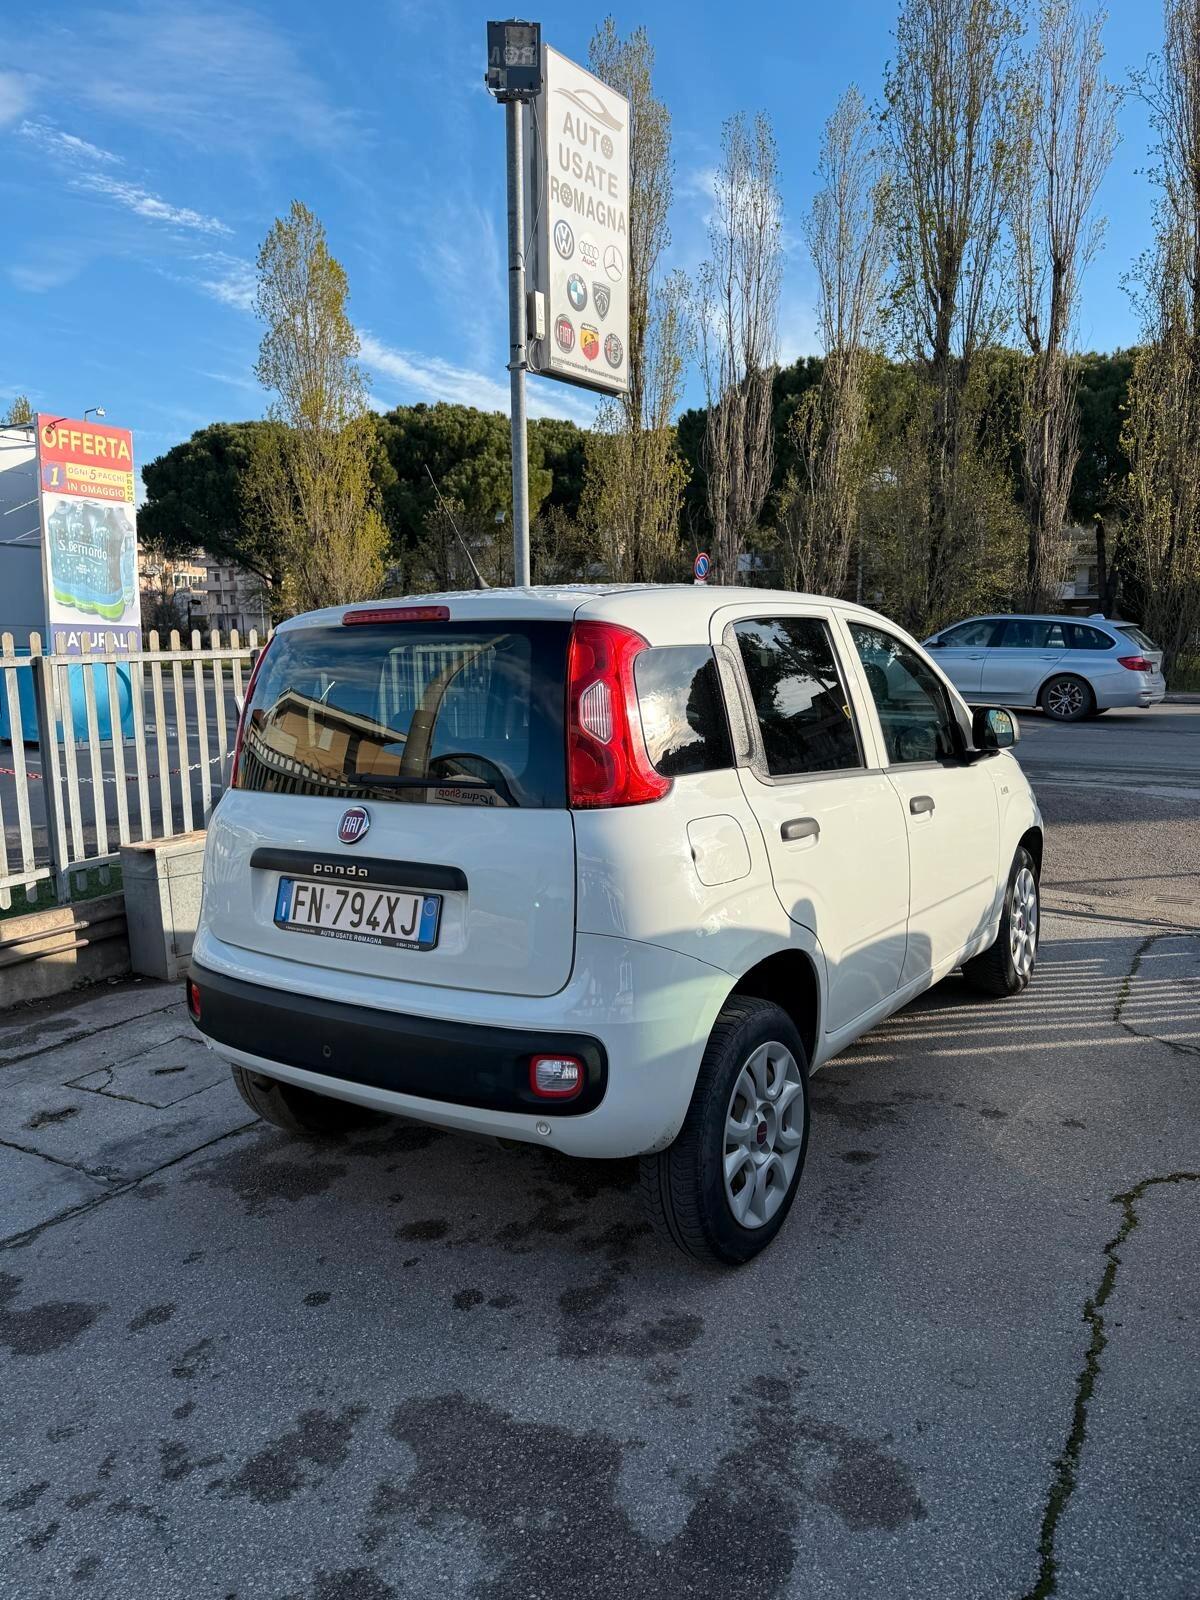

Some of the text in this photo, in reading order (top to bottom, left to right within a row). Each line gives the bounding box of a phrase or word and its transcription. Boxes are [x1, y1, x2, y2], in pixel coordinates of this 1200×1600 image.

[563, 111, 614, 160] AUTO
[558, 142, 618, 199] USATE
[551, 175, 626, 236] ROMAGNA
[559, 324, 572, 347] FIAT
[41, 425, 131, 461] OFFERTA
[50, 466, 59, 486] 1
[68, 466, 125, 483] OGNI 5 PACCHI
[67, 482, 125, 497] IN OMAGGIO
[341, 816, 364, 834] FIAT
[313, 863, 368, 877] panda
[292, 885, 419, 936] FN 794XJ
[320, 929, 334, 937] AUTO
[335, 932, 353, 941] USATE
[353, 934, 382, 945] ROMAGNA
